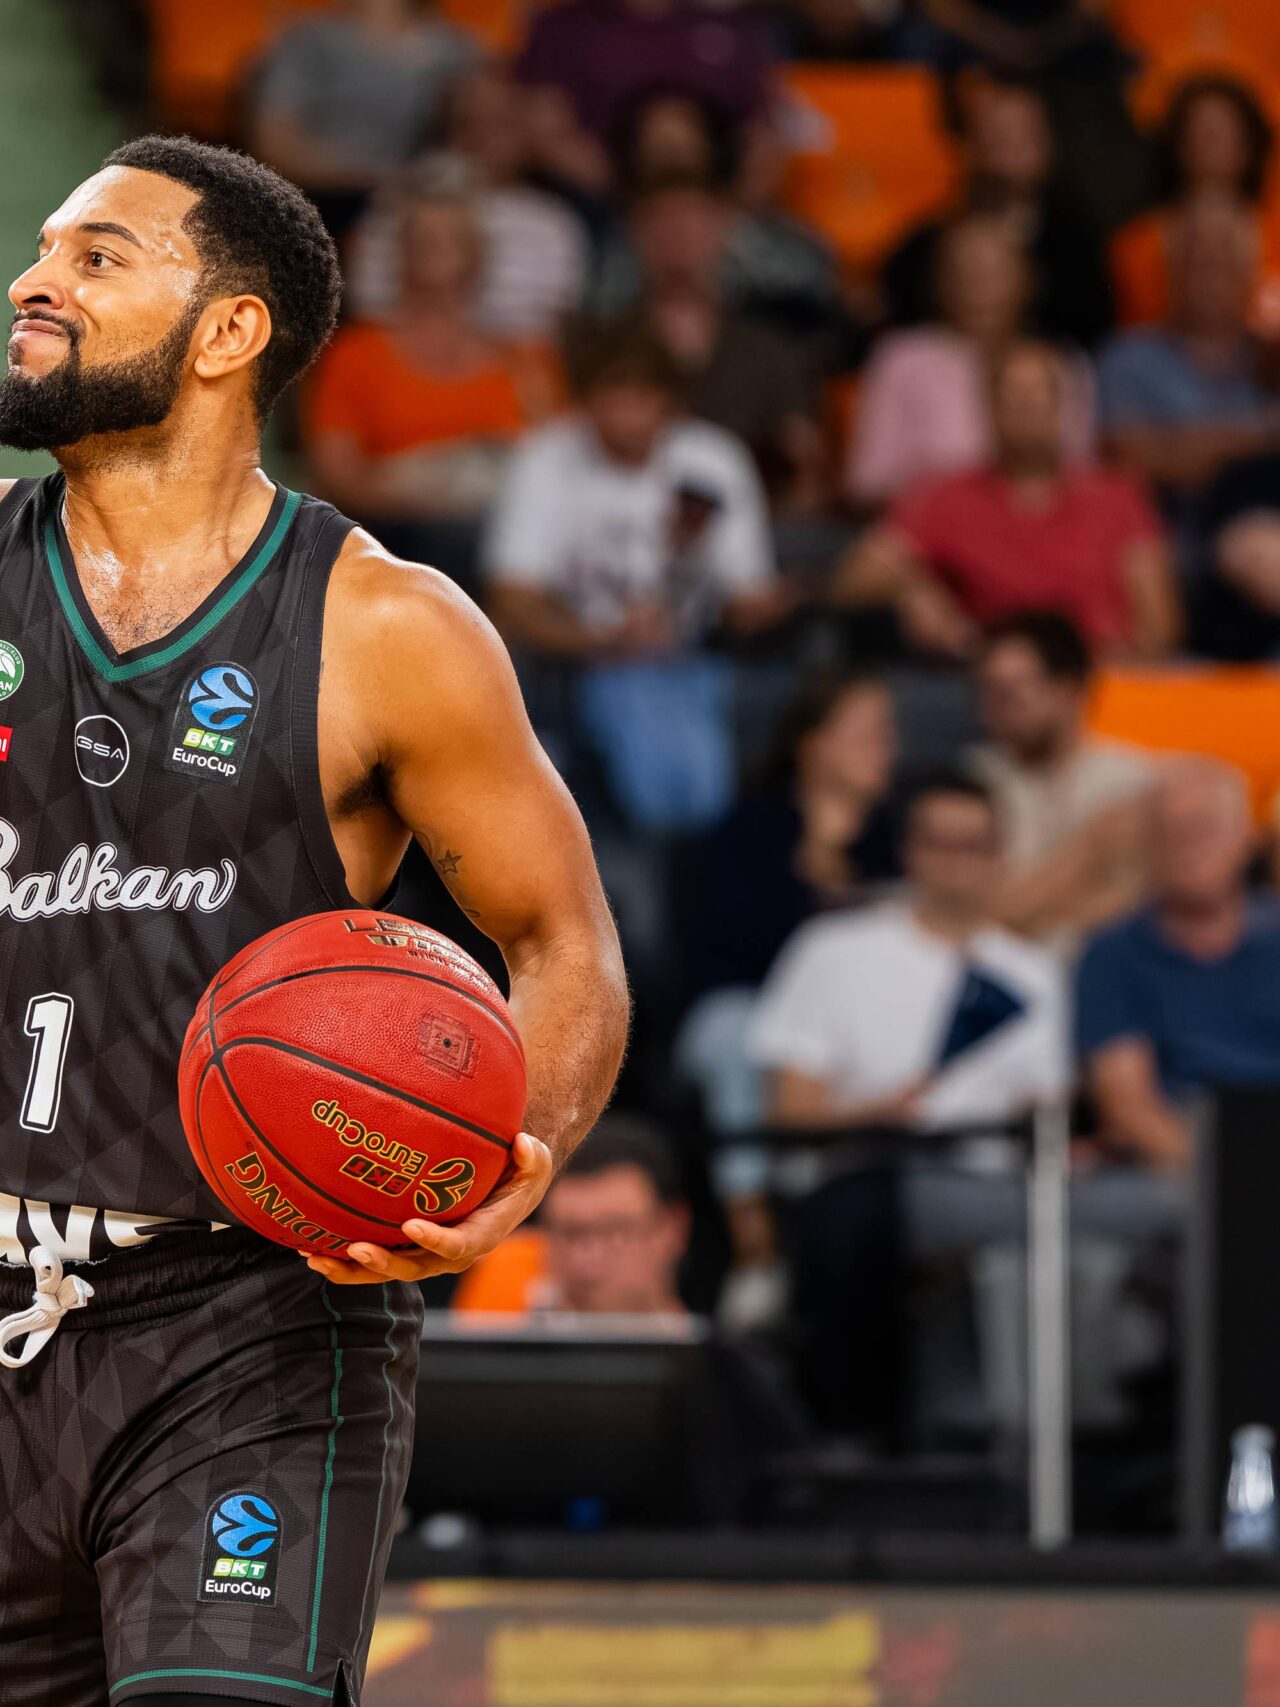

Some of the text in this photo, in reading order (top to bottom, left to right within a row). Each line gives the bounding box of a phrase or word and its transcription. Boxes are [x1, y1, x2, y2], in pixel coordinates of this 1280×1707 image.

[10, 650, 21, 665] CLUB
[76, 735, 125, 761] GSA
[185, 730, 235, 753] BKT
[172, 747, 237, 777] EuroCup
[20, 992, 74, 1134] 1
[312, 1099, 428, 1177] EuroCup
[342, 1156, 412, 1194] BKT
[215, 1559, 266, 1578] BKT
[205, 1579, 272, 1600] EuroCup
